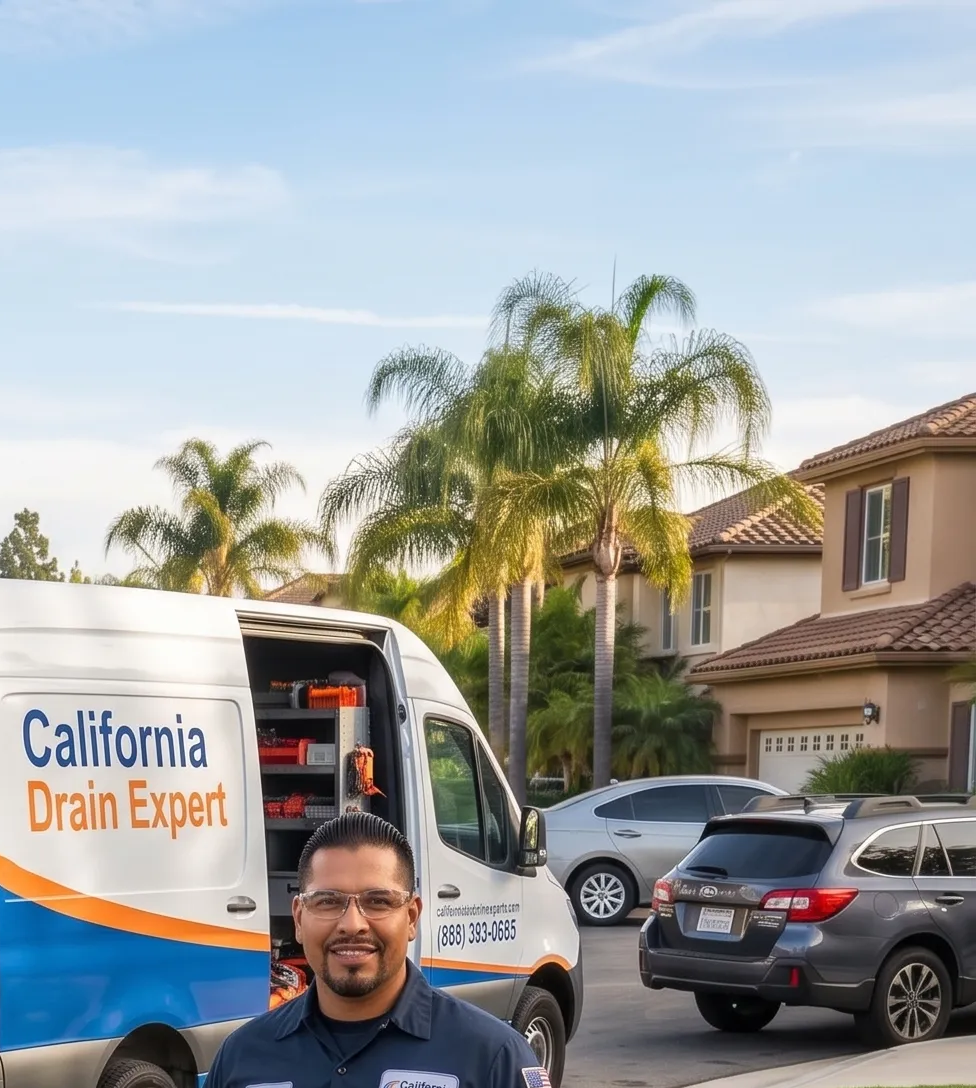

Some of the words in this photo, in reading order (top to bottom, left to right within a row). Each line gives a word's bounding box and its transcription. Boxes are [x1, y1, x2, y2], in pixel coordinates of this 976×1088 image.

[22, 709, 208, 768] California
[27, 780, 119, 832] Drain
[128, 780, 228, 840] Expert
[438, 923, 466, 953] (888)
[468, 919, 516, 944] 393-0685
